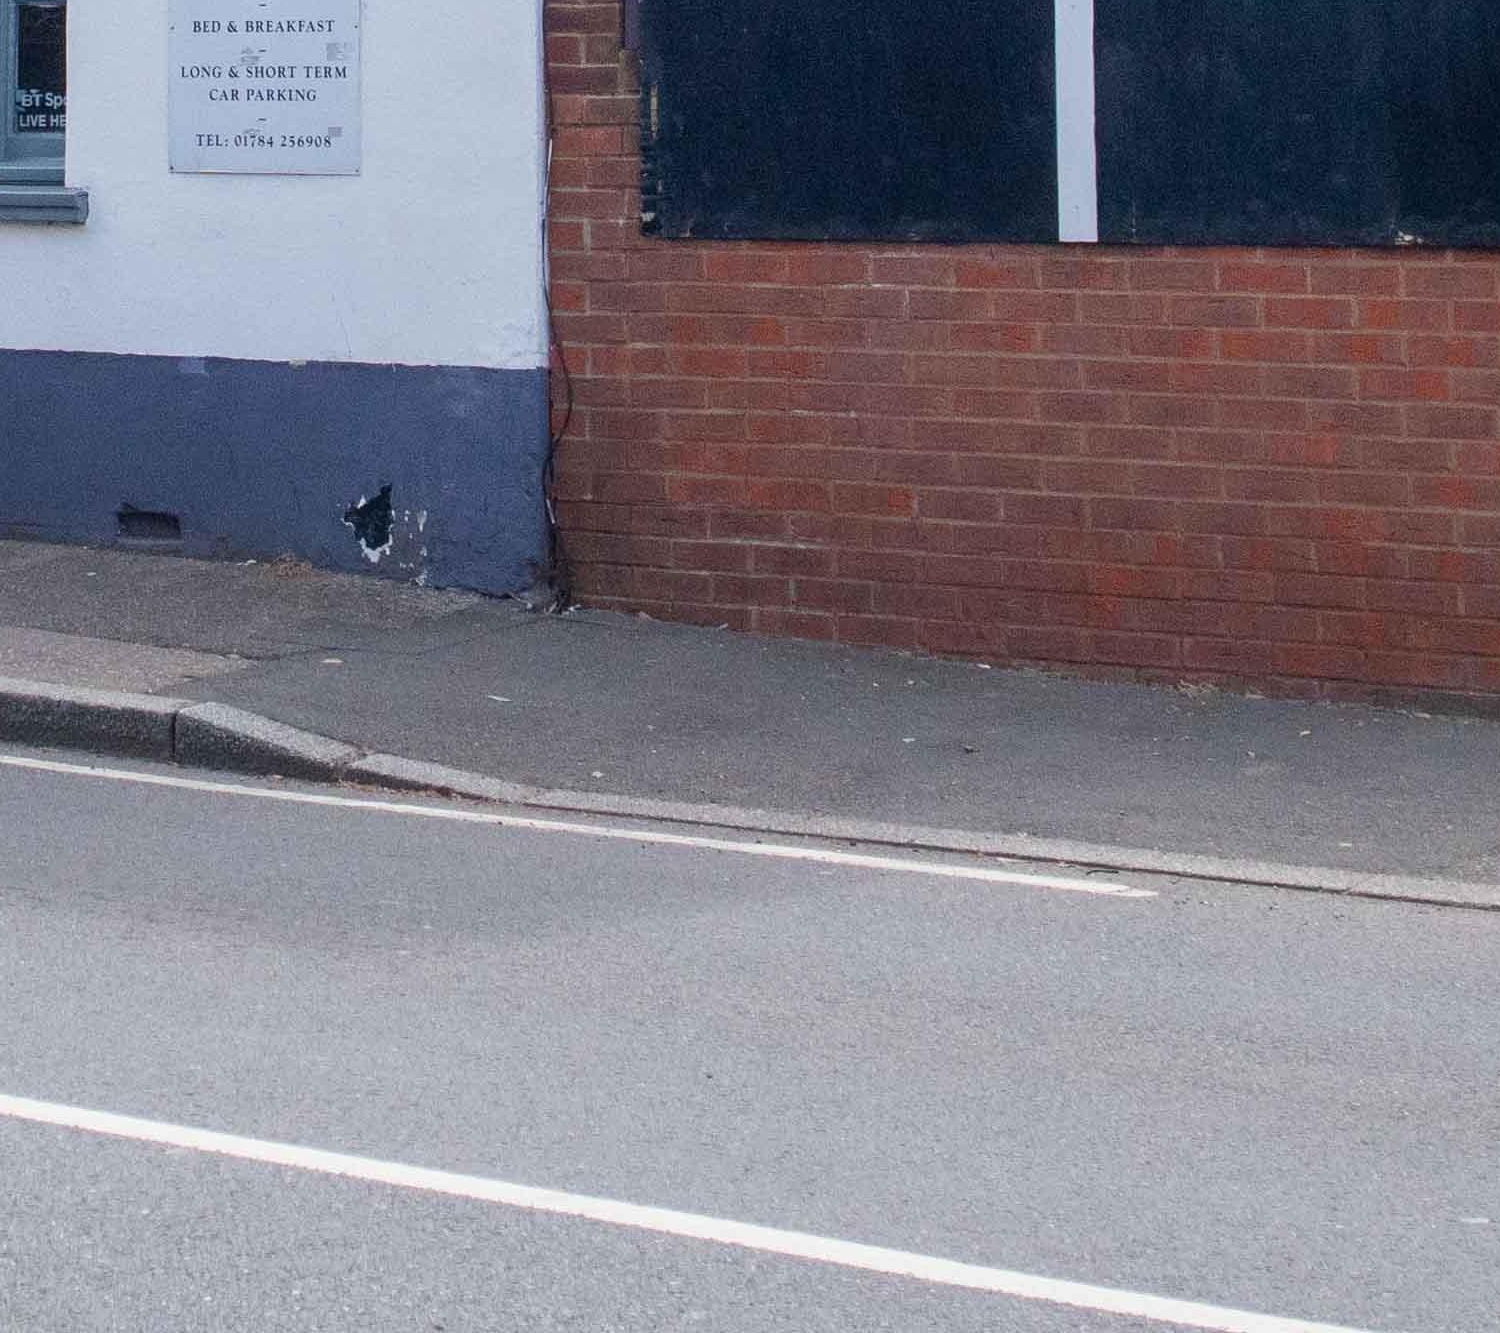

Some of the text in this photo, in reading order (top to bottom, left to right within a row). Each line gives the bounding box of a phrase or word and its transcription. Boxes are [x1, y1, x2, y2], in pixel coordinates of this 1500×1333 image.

[192, 19, 336, 34] BED & BREAKFAST
[180, 66, 348, 80] LONG & SHORT TERM
[22, 92, 67, 109] BT Sp
[208, 88, 318, 103] CAR PARKING
[19, 114, 47, 127] LIVE
[196, 133, 333, 149] TEL: 01784 256908
